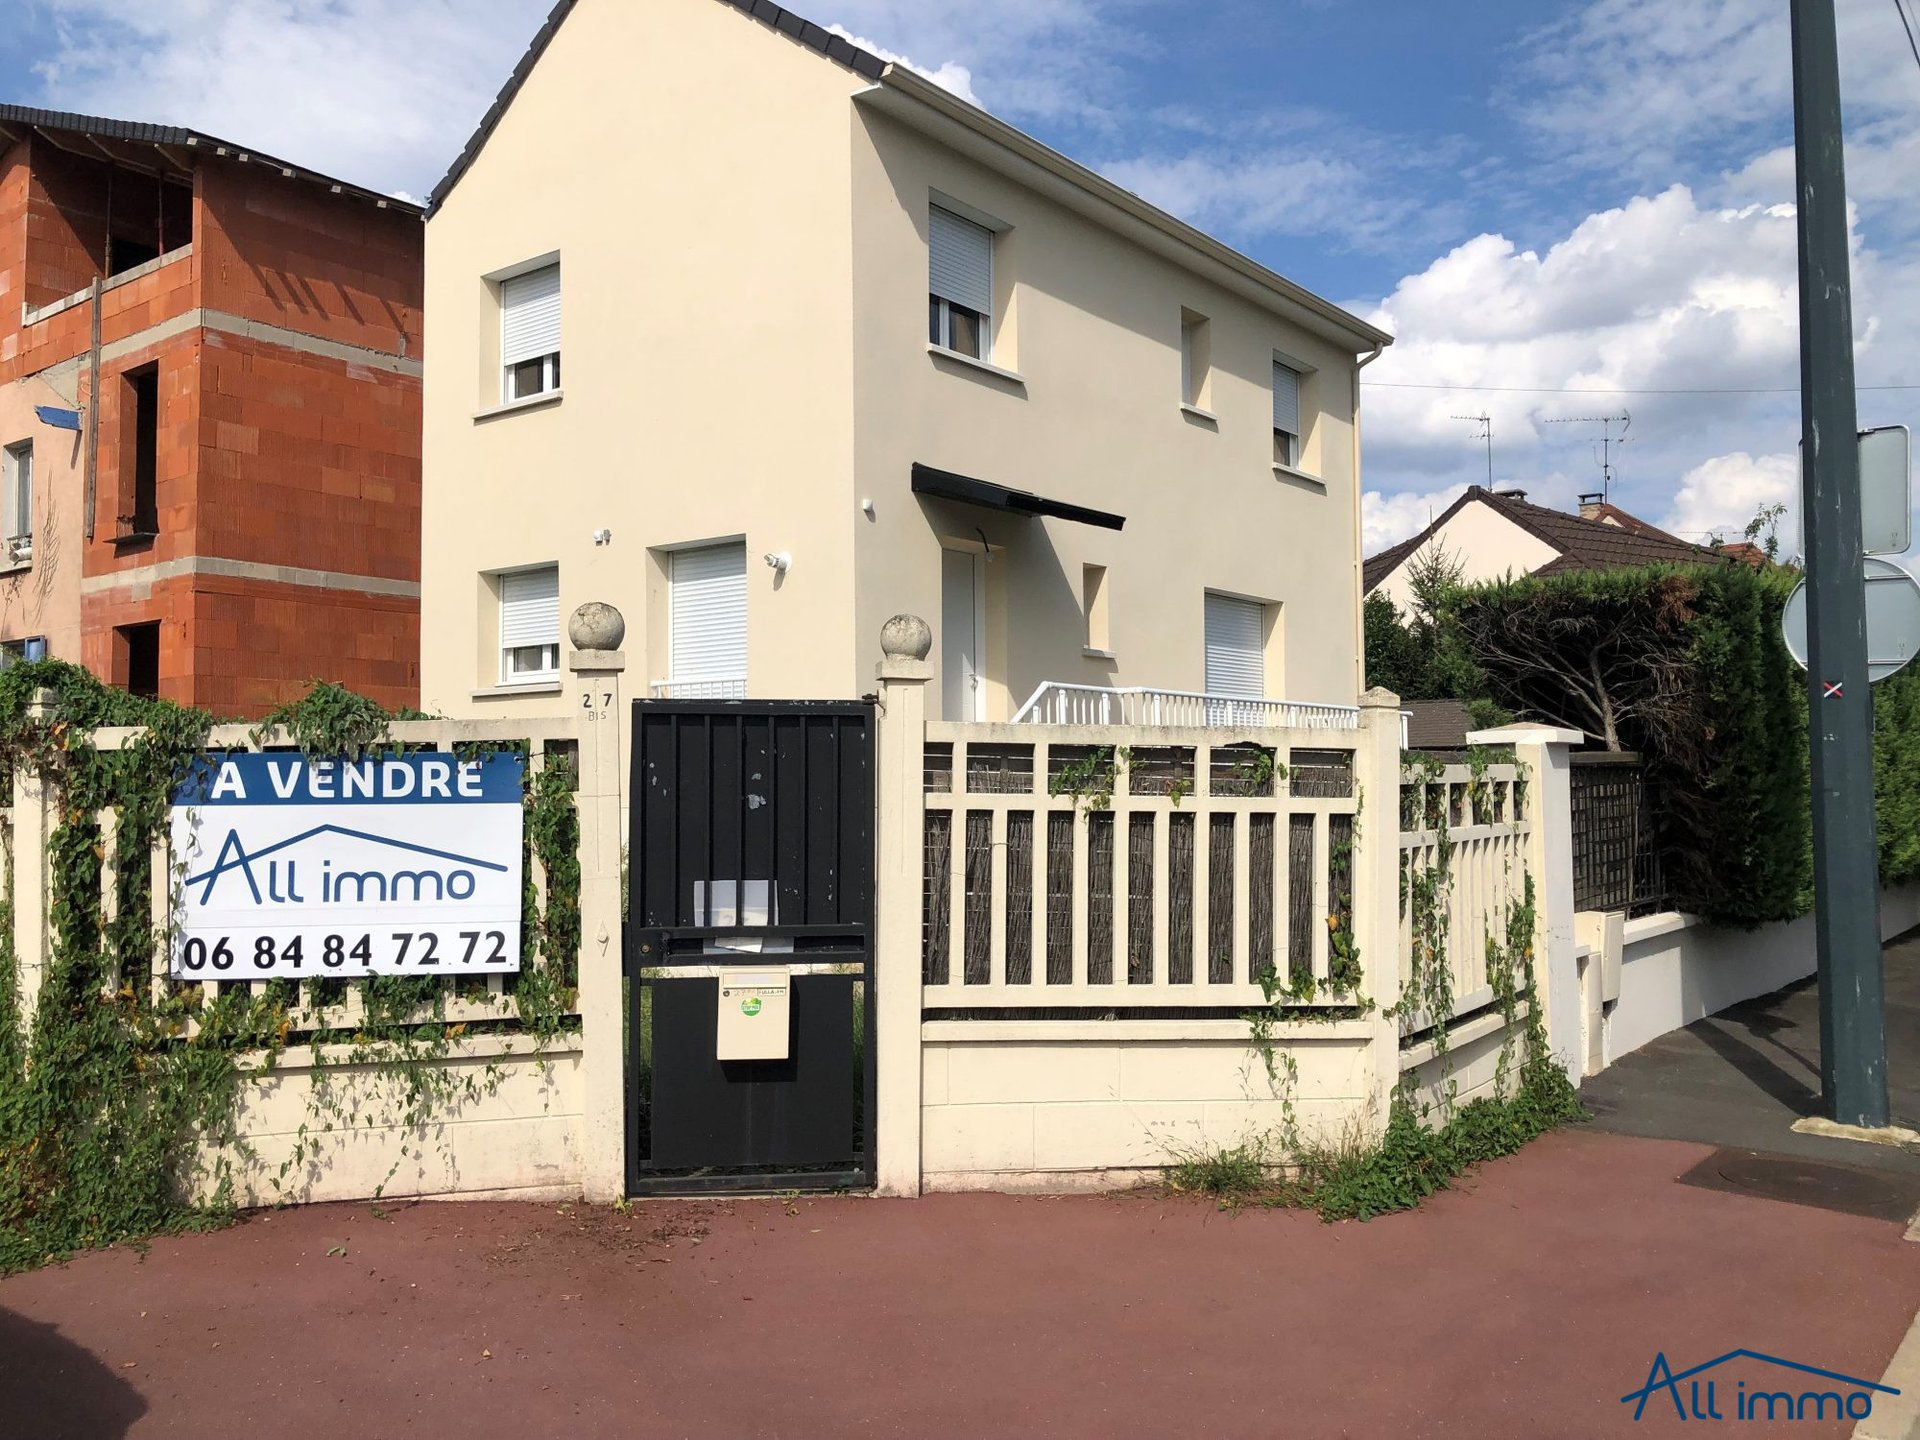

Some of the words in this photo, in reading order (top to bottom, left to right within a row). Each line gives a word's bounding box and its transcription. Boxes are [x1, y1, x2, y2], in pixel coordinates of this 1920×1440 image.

[211, 761, 248, 799] A
[267, 760, 483, 799] VENDRE
[190, 827, 304, 905] All
[322, 860, 475, 902] immo
[184, 936, 234, 970] 06
[254, 934, 304, 969] 84
[322, 933, 372, 967] 84
[391, 932, 439, 966] 72
[459, 930, 507, 964] 72
